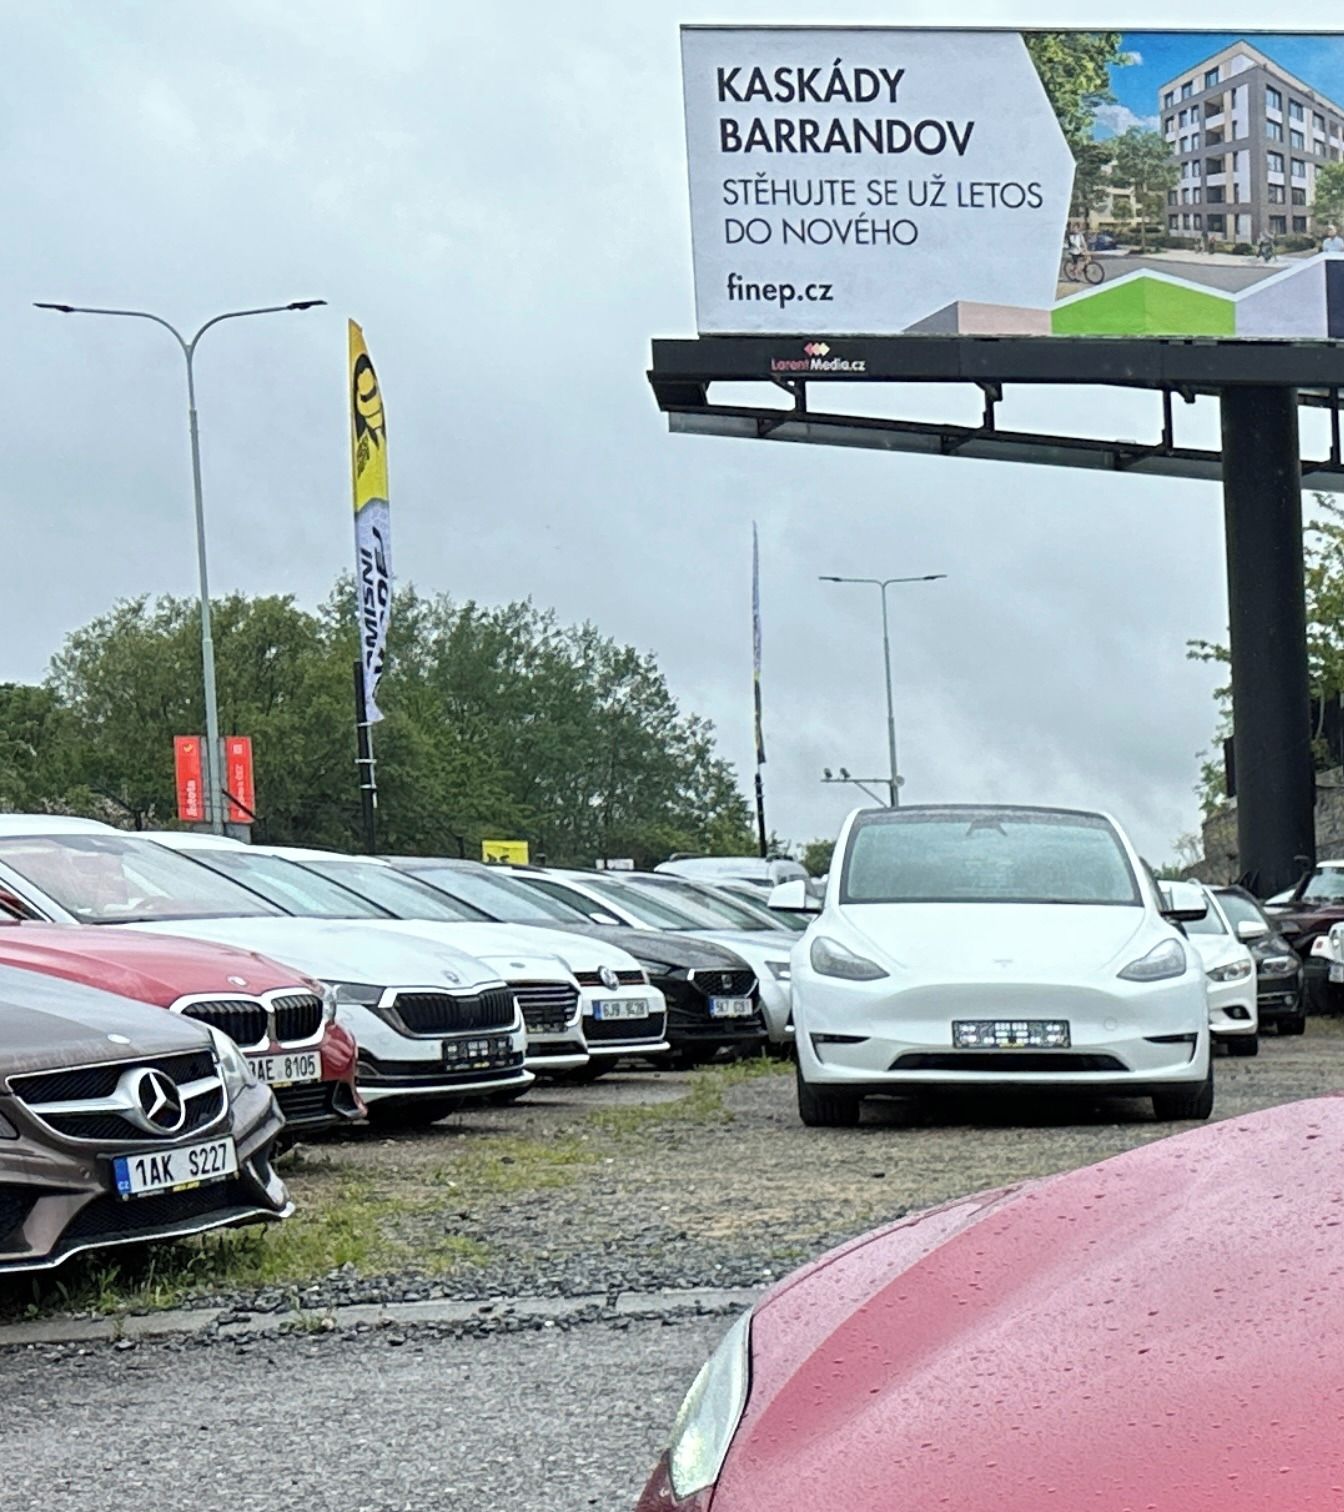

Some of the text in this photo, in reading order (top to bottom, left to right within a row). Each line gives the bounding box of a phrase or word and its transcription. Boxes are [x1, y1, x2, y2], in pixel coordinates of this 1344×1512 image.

[716, 57, 906, 103] KASKÁDY
[719, 117, 975, 157] BARRANDOV
[722, 171, 1044, 209] STĚHUJTE SE UŽ LETOS
[724, 211, 919, 246] DO NOVÉHO
[726, 271, 834, 309] finep.cz
[284, 1054, 316, 1079] 8105
[135, 1142, 228, 1187] 1AK S227
